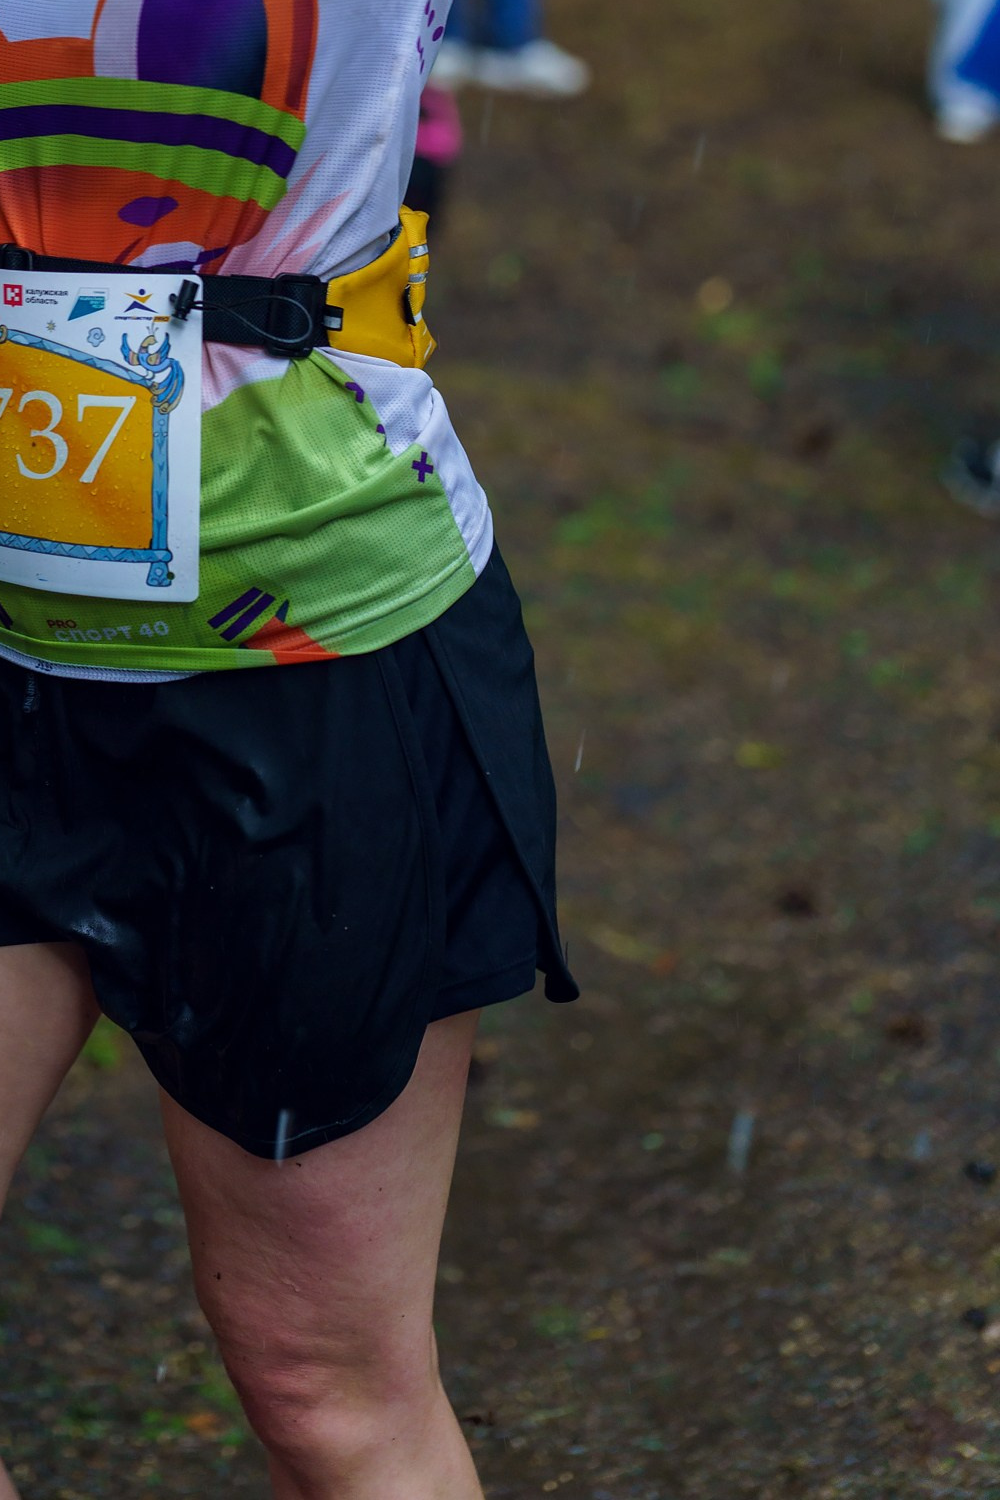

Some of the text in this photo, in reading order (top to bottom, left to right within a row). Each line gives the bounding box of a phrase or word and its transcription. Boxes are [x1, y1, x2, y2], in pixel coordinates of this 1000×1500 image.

[25, 288, 69, 297] калужская
[25, 296, 58, 305] область
[46, 619, 77, 629] PRO
[54, 620, 169, 642] СПОРТ 40
